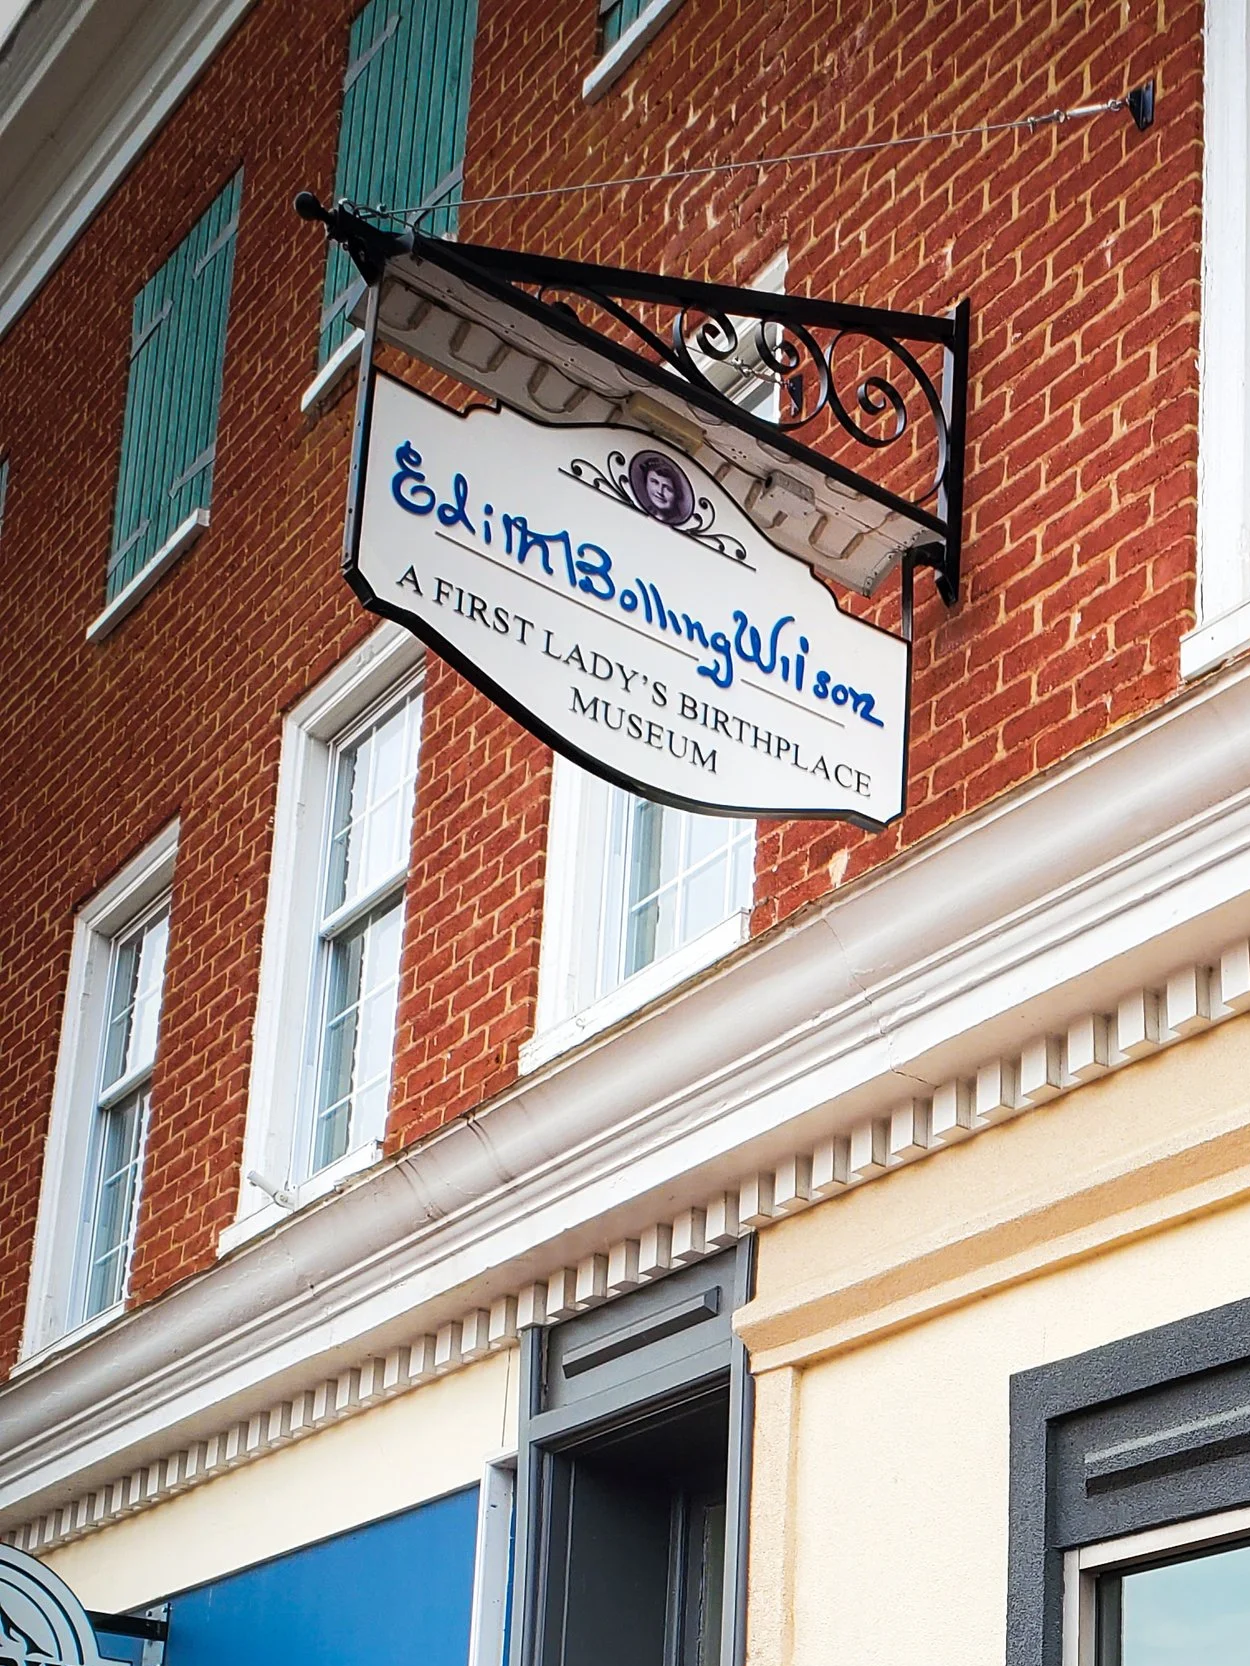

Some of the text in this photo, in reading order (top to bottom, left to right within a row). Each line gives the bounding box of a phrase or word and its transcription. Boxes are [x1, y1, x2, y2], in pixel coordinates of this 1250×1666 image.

[391, 440, 885, 728] Edith Bolling Wilson
[396, 564, 873, 798] A FIRST LADY'S BIRTHPLACE
[569, 686, 720, 776] MUSEUM
